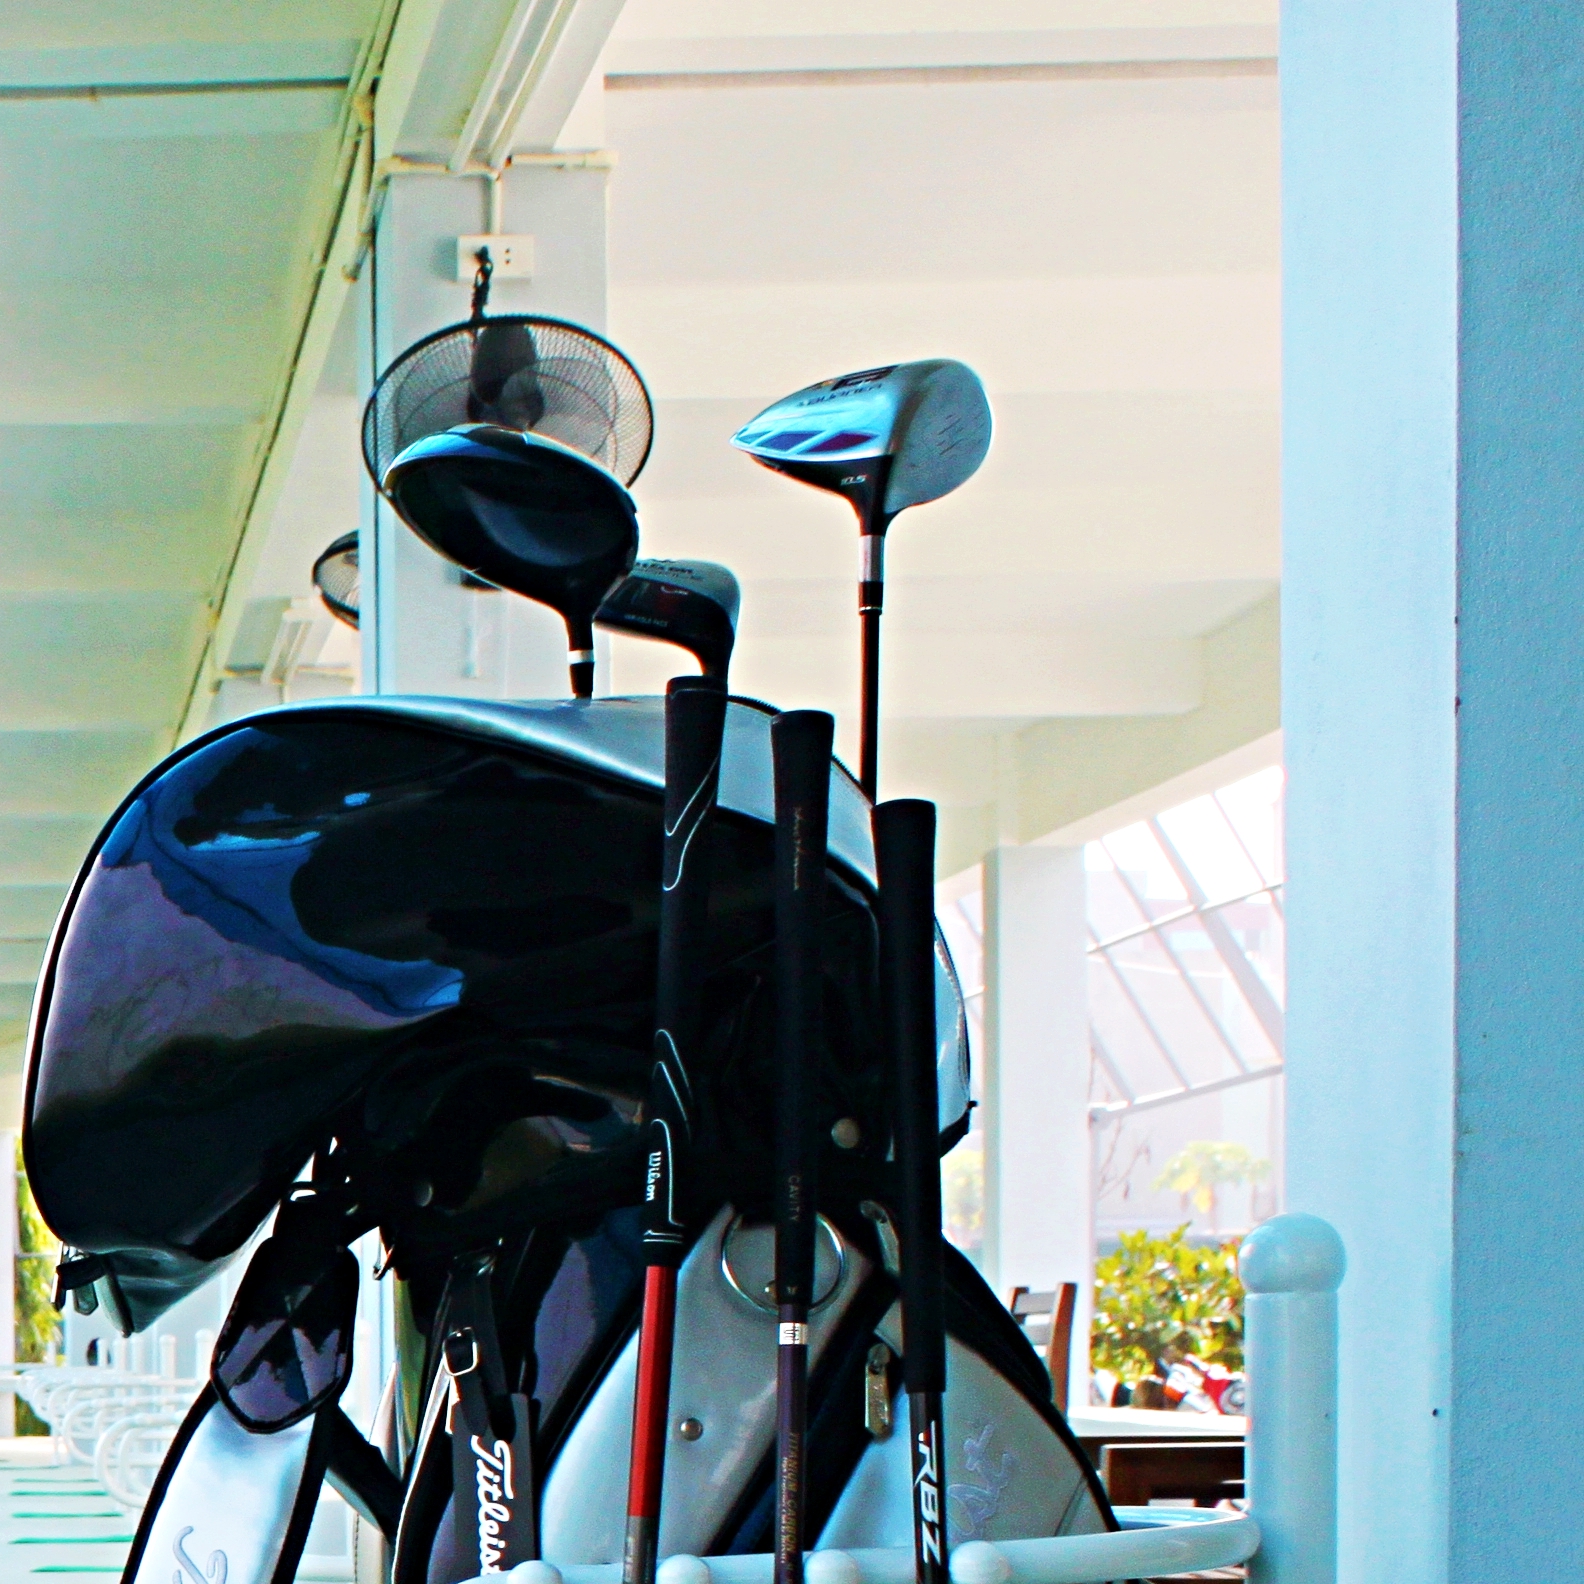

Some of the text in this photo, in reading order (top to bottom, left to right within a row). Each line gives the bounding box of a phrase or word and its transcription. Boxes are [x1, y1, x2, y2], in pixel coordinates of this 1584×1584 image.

[646, 1150, 662, 1202] Wilson
[470, 1434, 514, 1576] Titleis
[913, 1420, 941, 1567] RBZ
